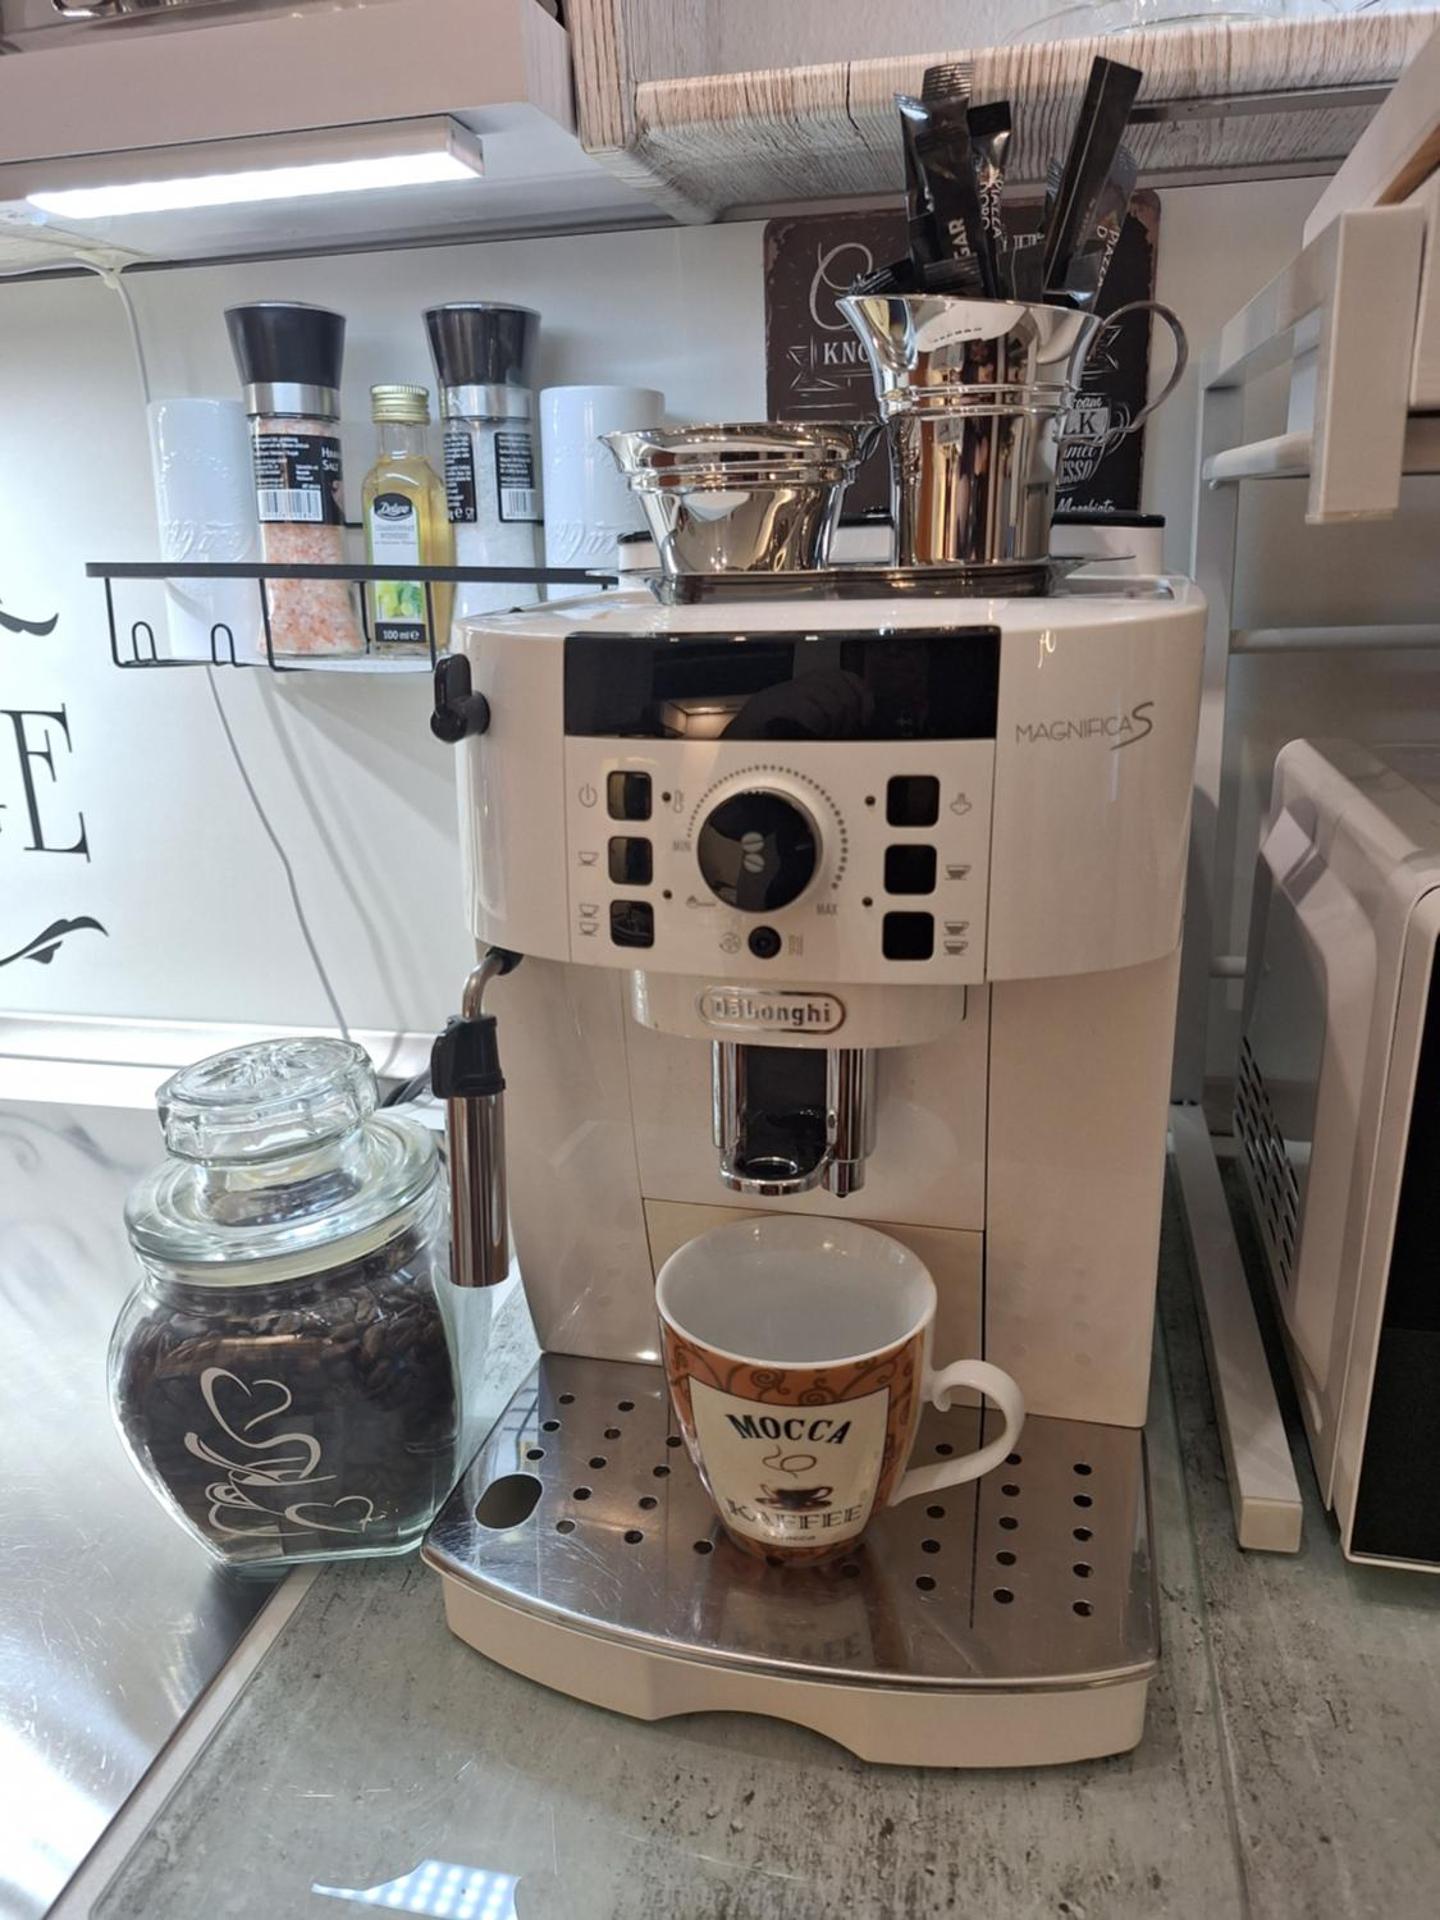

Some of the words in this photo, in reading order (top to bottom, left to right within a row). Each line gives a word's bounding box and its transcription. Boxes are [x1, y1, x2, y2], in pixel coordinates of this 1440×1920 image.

[948, 218, 971, 260] GAR
[823, 341, 869, 365] KNO
[1063, 412, 1097, 434] LK
[1016, 716, 1134, 744] MAGNIFICA
[0, 703, 91, 863] E
[726, 1414, 852, 1444] MOCCA
[726, 1498, 863, 1530] KAFFEE
